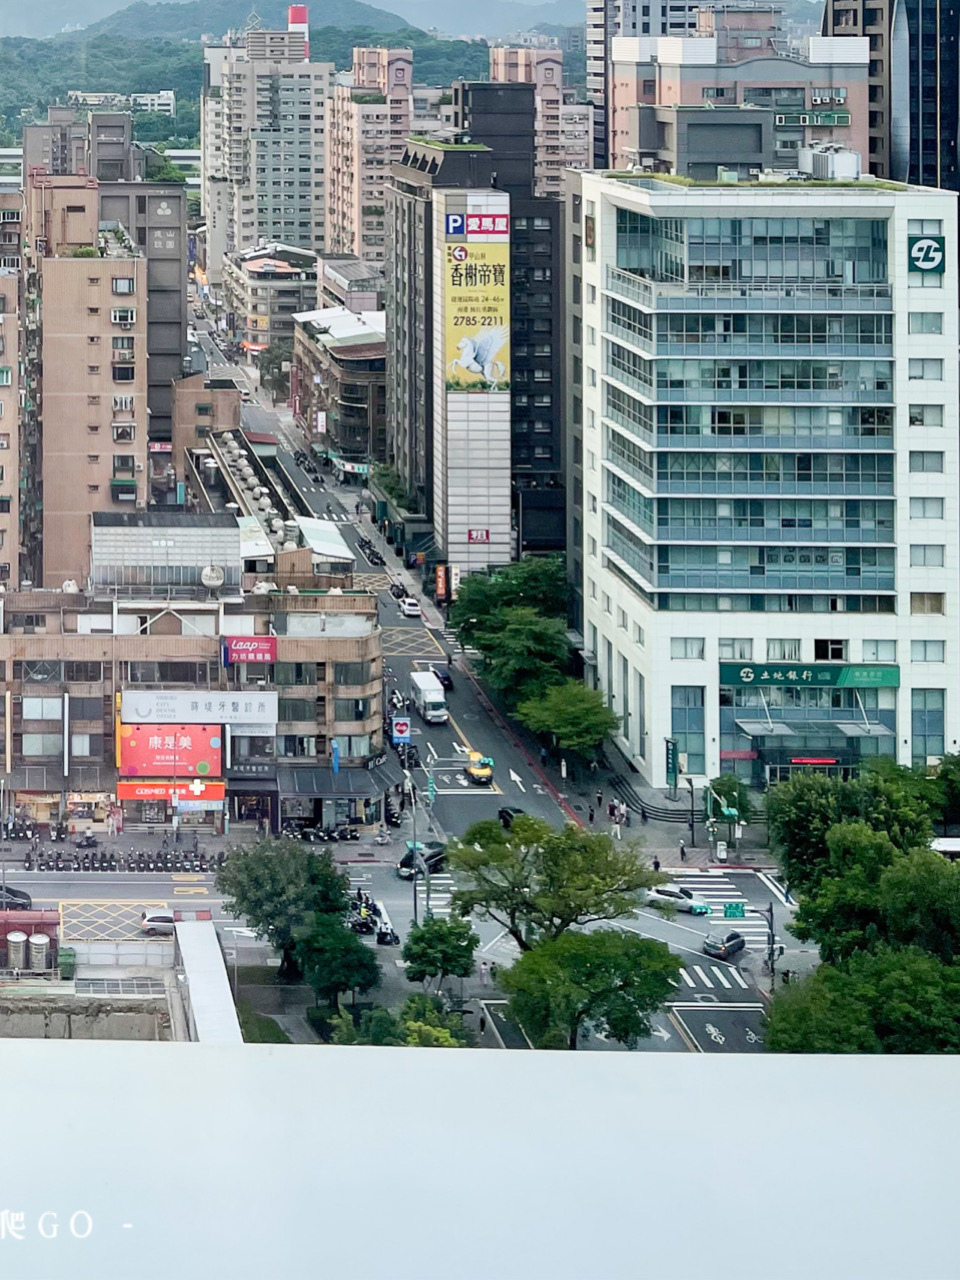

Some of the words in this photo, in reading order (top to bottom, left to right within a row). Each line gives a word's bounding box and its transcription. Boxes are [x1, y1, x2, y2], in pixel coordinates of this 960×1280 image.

[449, 215, 462, 233] P
[467, 217, 508, 231] 愛馬屋
[450, 263, 506, 287] 香榭帝寶
[453, 316, 503, 326] 2785-2211
[760, 670, 813, 681] 土地銀行
[148, 735, 192, 750] 康是美
